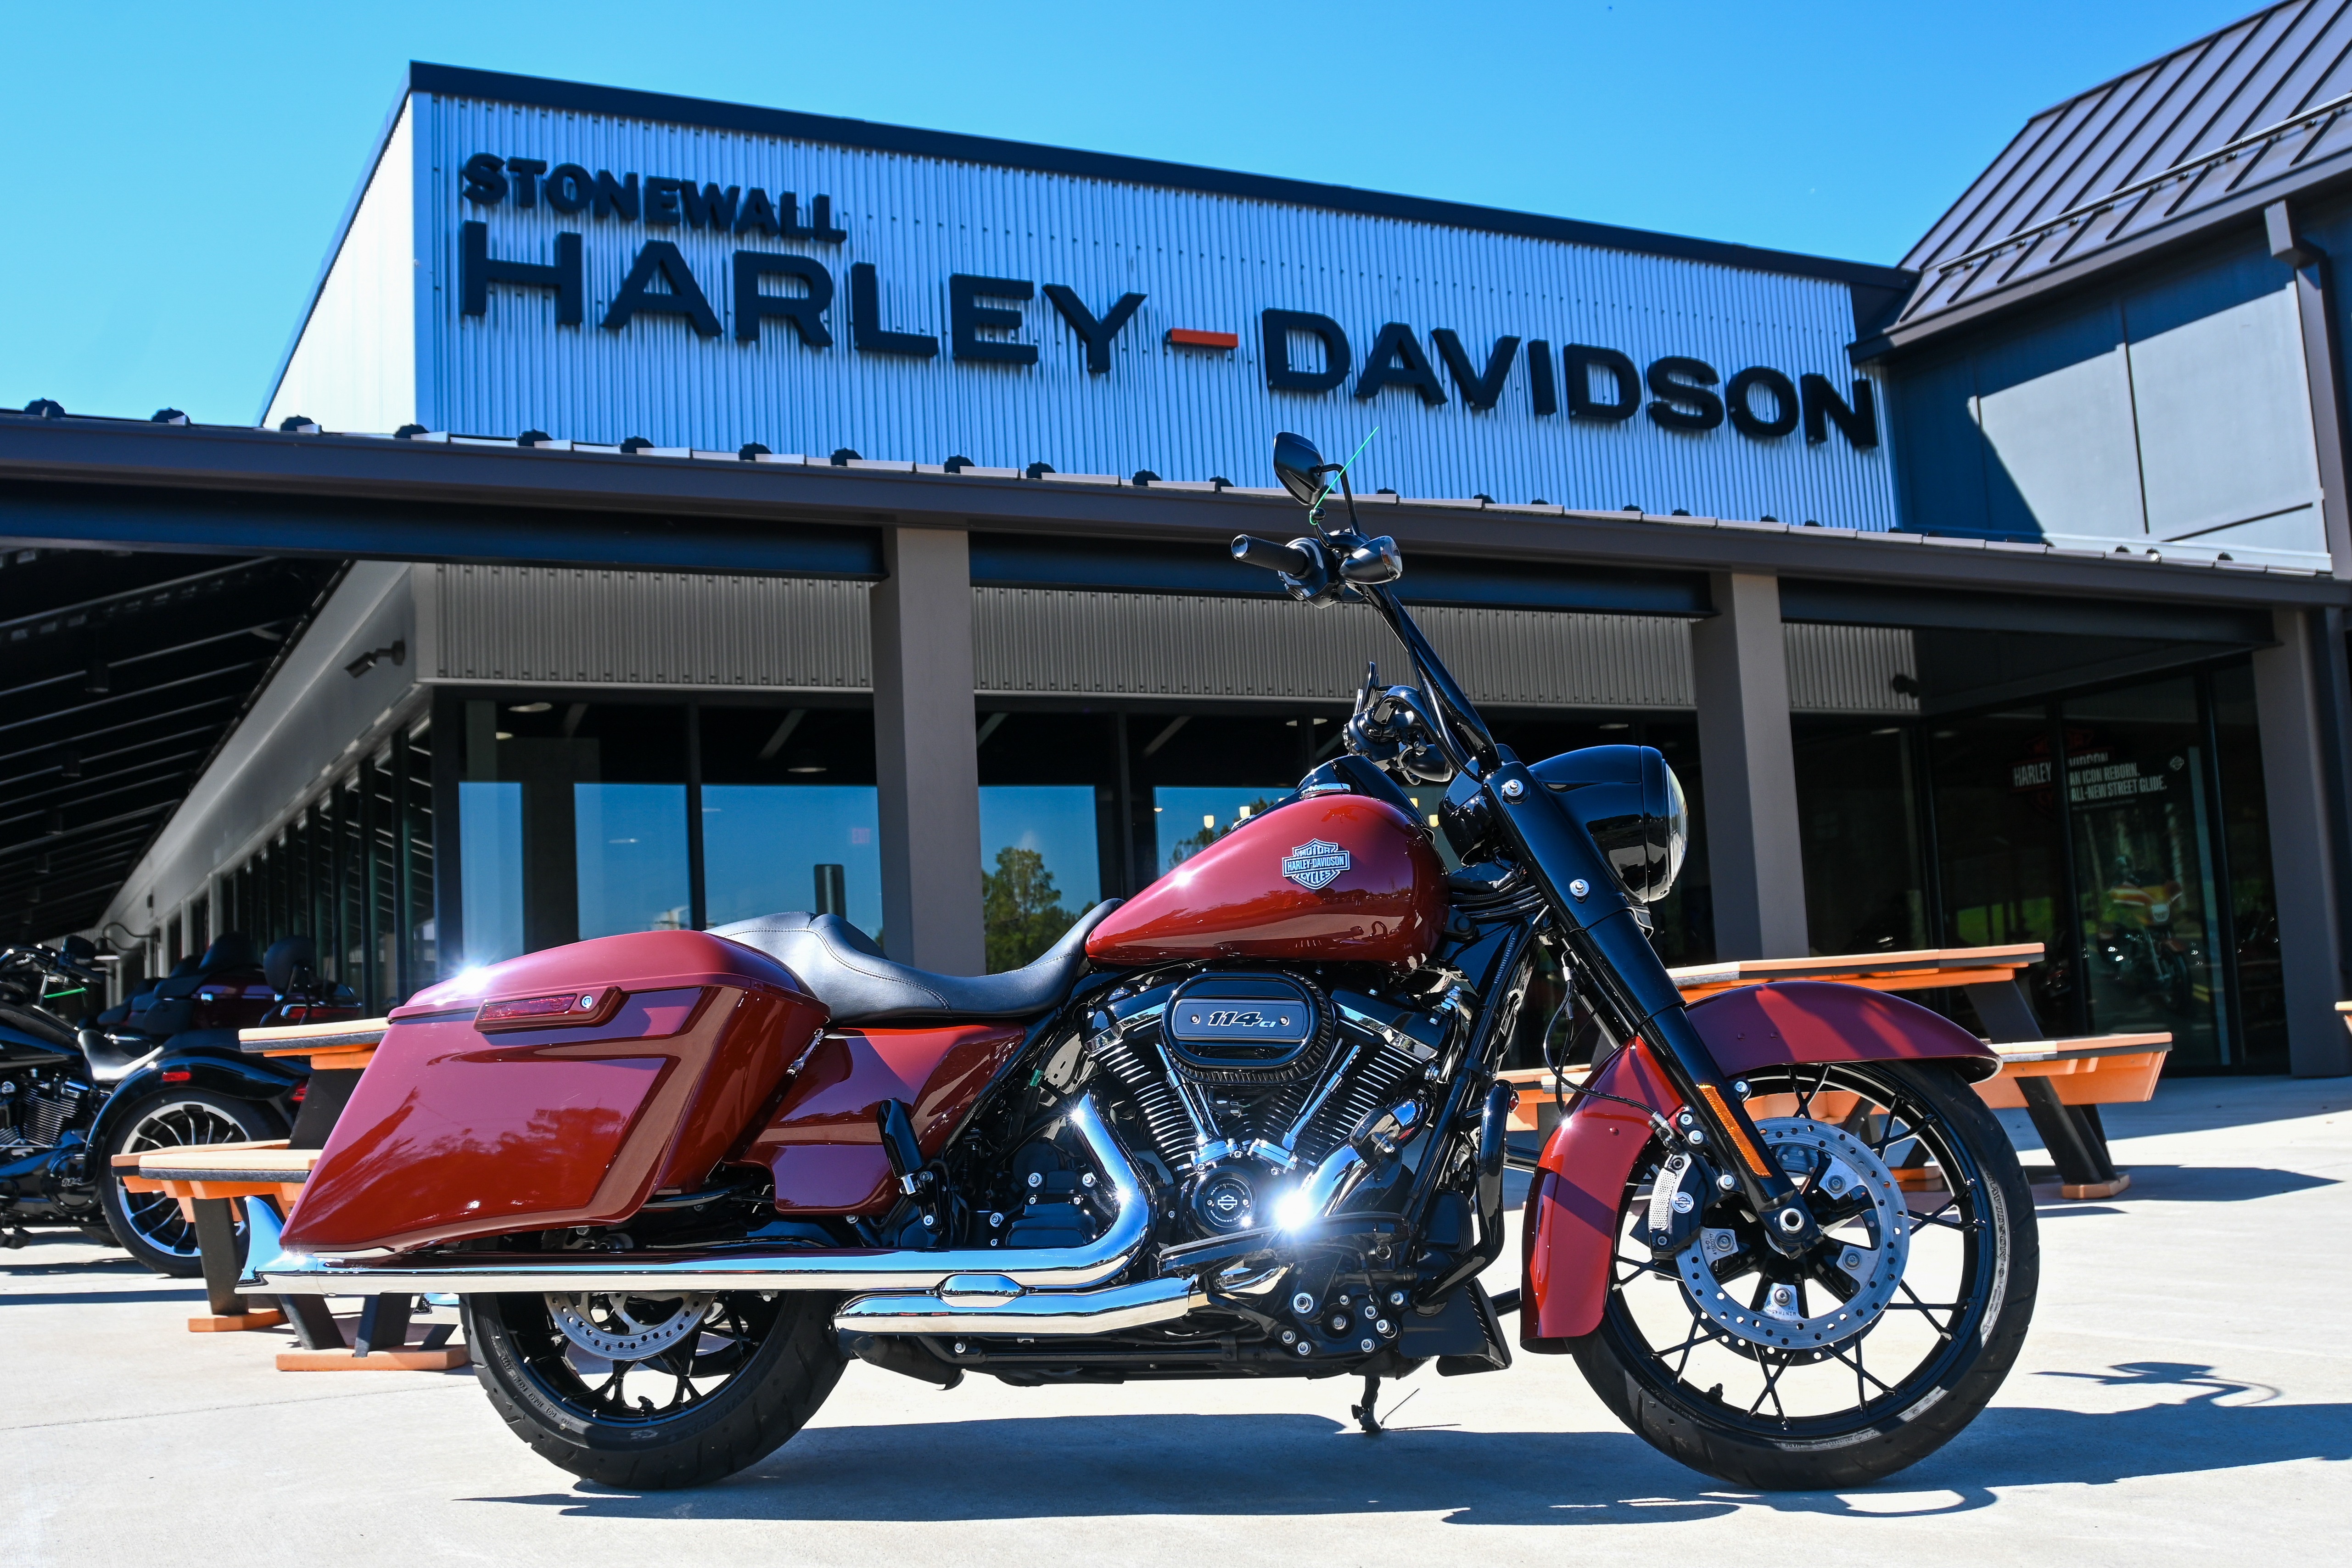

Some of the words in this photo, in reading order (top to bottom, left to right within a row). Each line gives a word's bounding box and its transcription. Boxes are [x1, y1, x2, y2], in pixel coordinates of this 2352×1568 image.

[463, 152, 846, 243] STONEWALL
[2014, 762, 2051, 787] HARLEY
[2069, 771, 2081, 786] AN
[2083, 767, 2102, 784] ICON
[2104, 763, 2140, 781] REBORN.
[2071, 784, 2107, 802] ALL-NEW
[2107, 779, 2138, 797] STREET
[2139, 774, 2167, 793] GLIDE.
[1300, 844, 1332, 857] MOTOR
[1287, 856, 1344, 872] HARLEY-DAVIDSON
[1300, 870, 1331, 884] CYCLES
